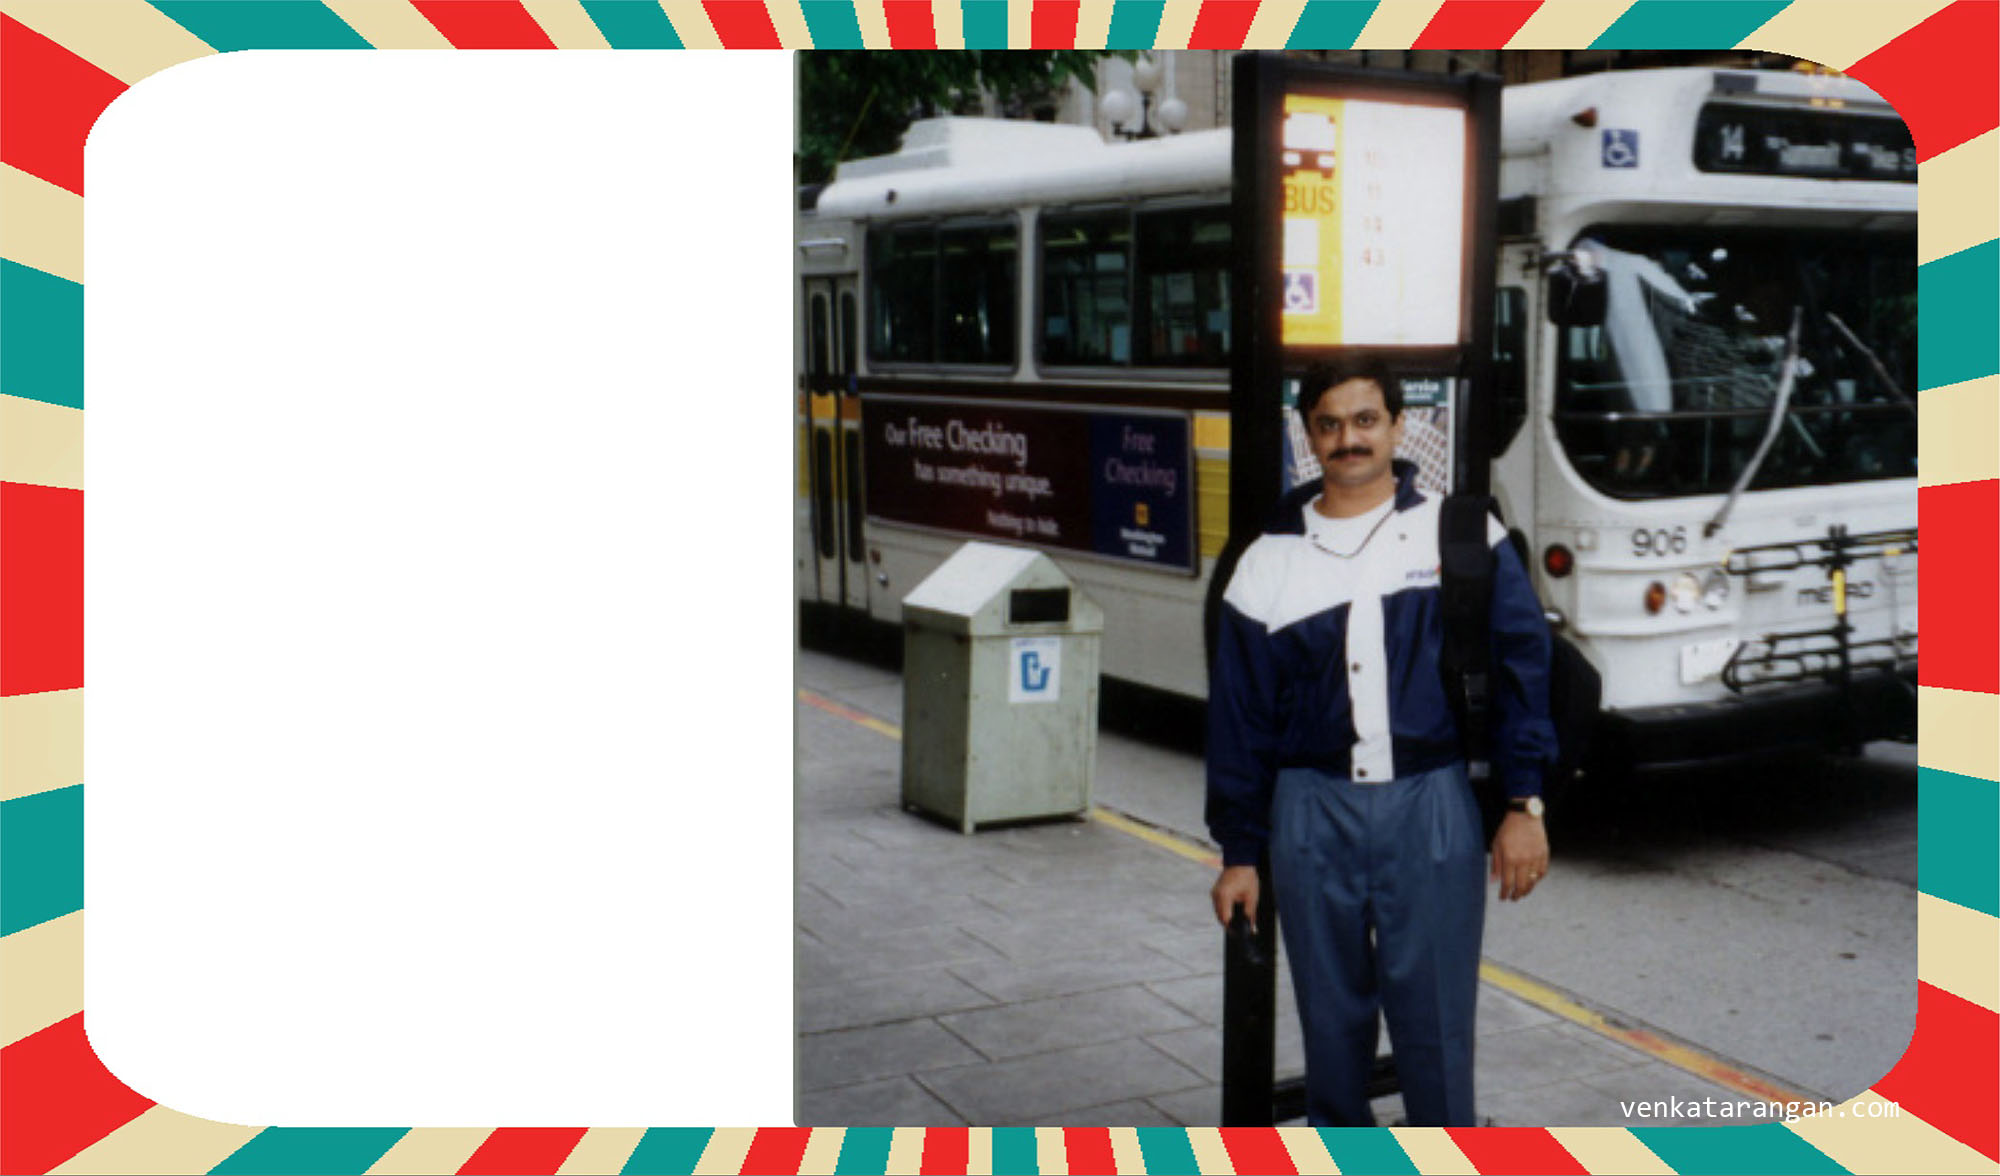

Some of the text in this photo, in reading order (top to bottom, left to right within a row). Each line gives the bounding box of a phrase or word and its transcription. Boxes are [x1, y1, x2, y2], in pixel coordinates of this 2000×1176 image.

[1720, 124, 1744, 160] 14
[1282, 184, 1335, 215] BUS
[908, 416, 943, 449] Free
[946, 419, 1028, 468] Checking
[1122, 425, 1154, 454] Free
[937, 462, 1001, 498] something
[1105, 457, 1176, 497] Checking
[1631, 525, 1688, 557] 906
